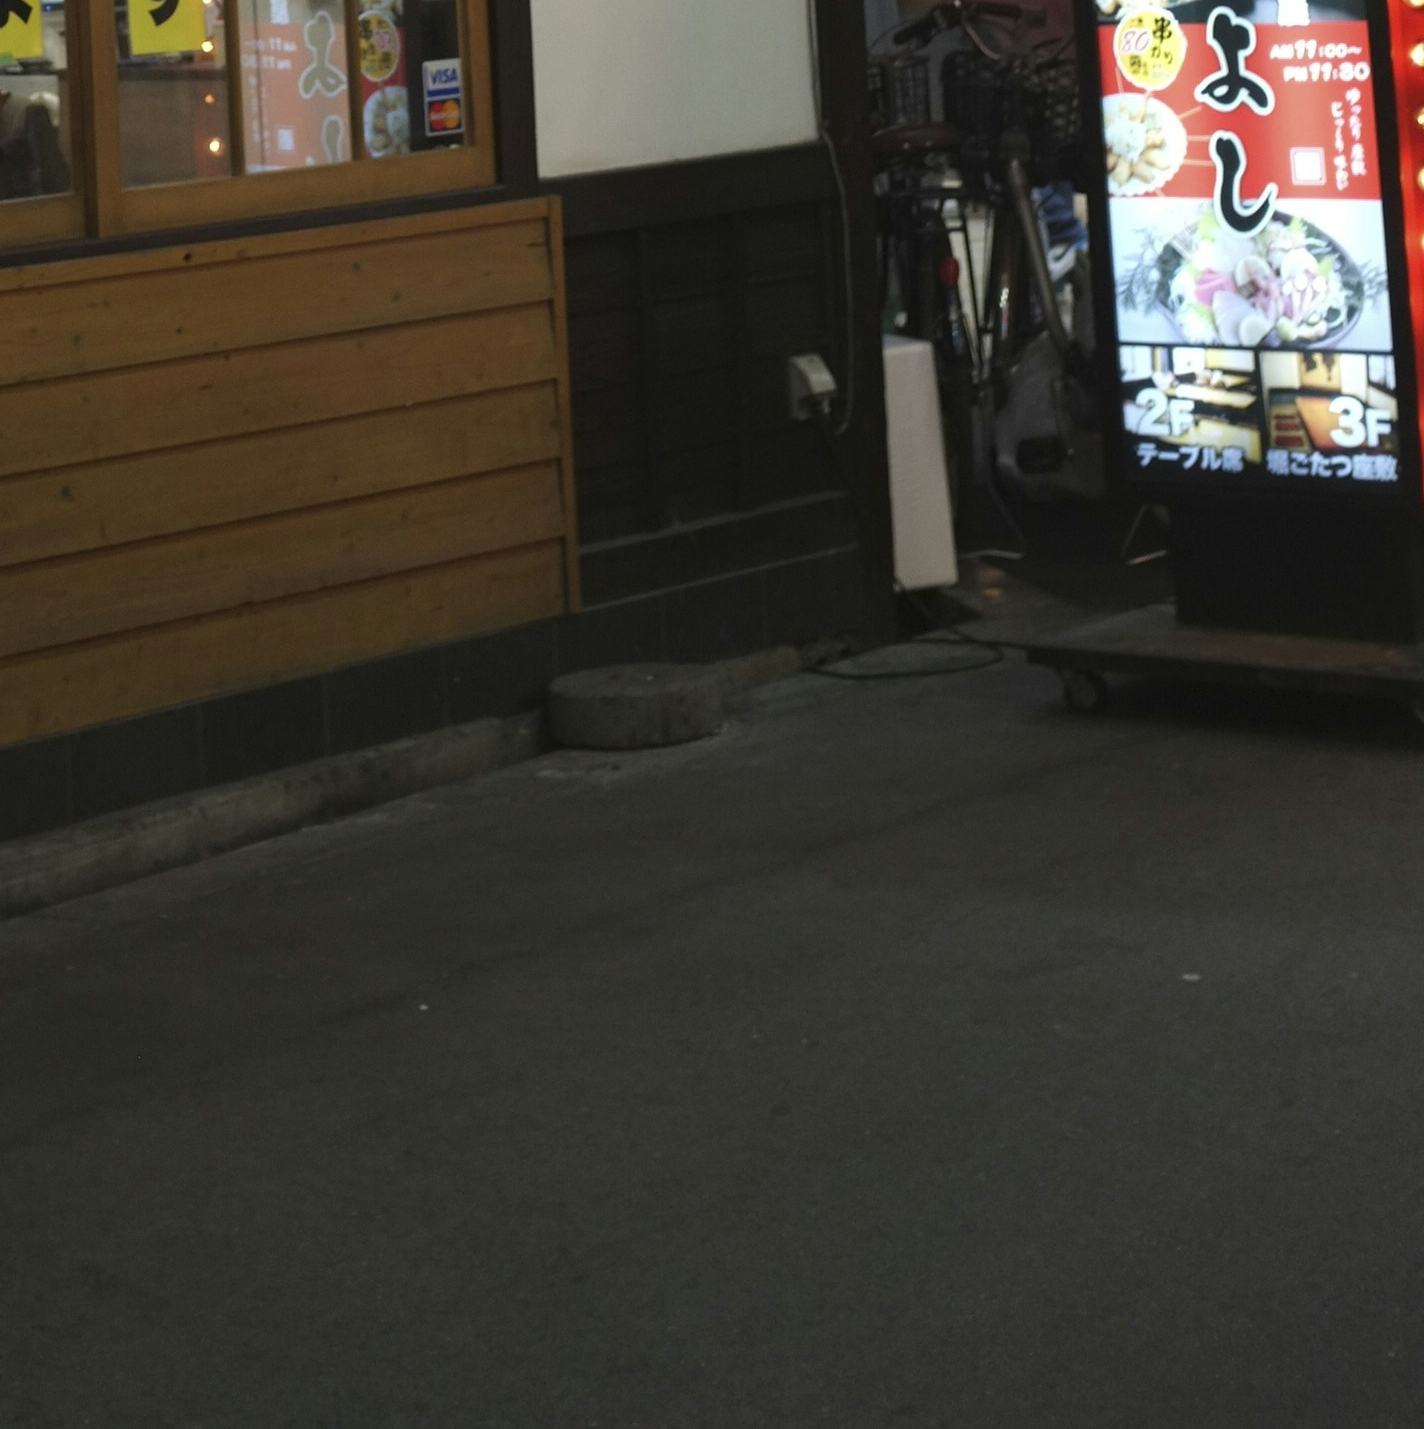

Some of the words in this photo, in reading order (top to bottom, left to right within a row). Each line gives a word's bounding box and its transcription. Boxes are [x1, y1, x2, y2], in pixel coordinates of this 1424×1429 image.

[431, 68, 458, 85] VISA
[1135, 388, 1195, 437] 2F
[1329, 396, 1392, 448] 3F
